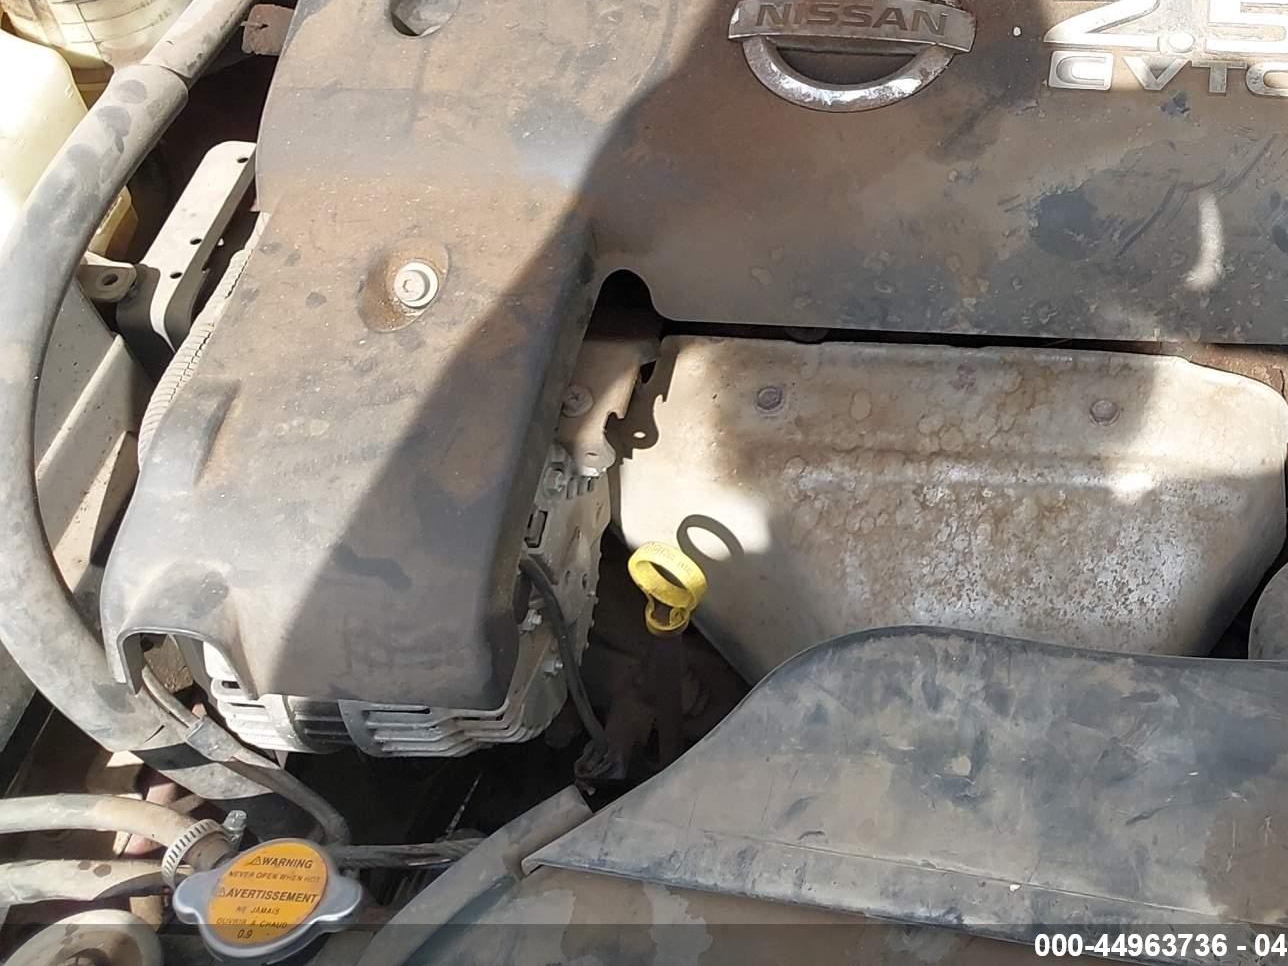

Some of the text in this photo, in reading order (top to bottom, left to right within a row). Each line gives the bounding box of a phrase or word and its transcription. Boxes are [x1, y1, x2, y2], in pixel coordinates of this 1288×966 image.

[755, 2, 951, 36] NISSAN
[261, 857, 313, 869] WARNING
[228, 871, 255, 879] NEVER
[255, 872, 278, 880] OPEN
[279, 874, 304, 883] WHEN
[225, 888, 319, 904] AVERTISSEMENT
[250, 905, 280, 915] JAMAIS
[259, 920, 288, 929] CHAUD
[236, 929, 254, 939] 0.9
